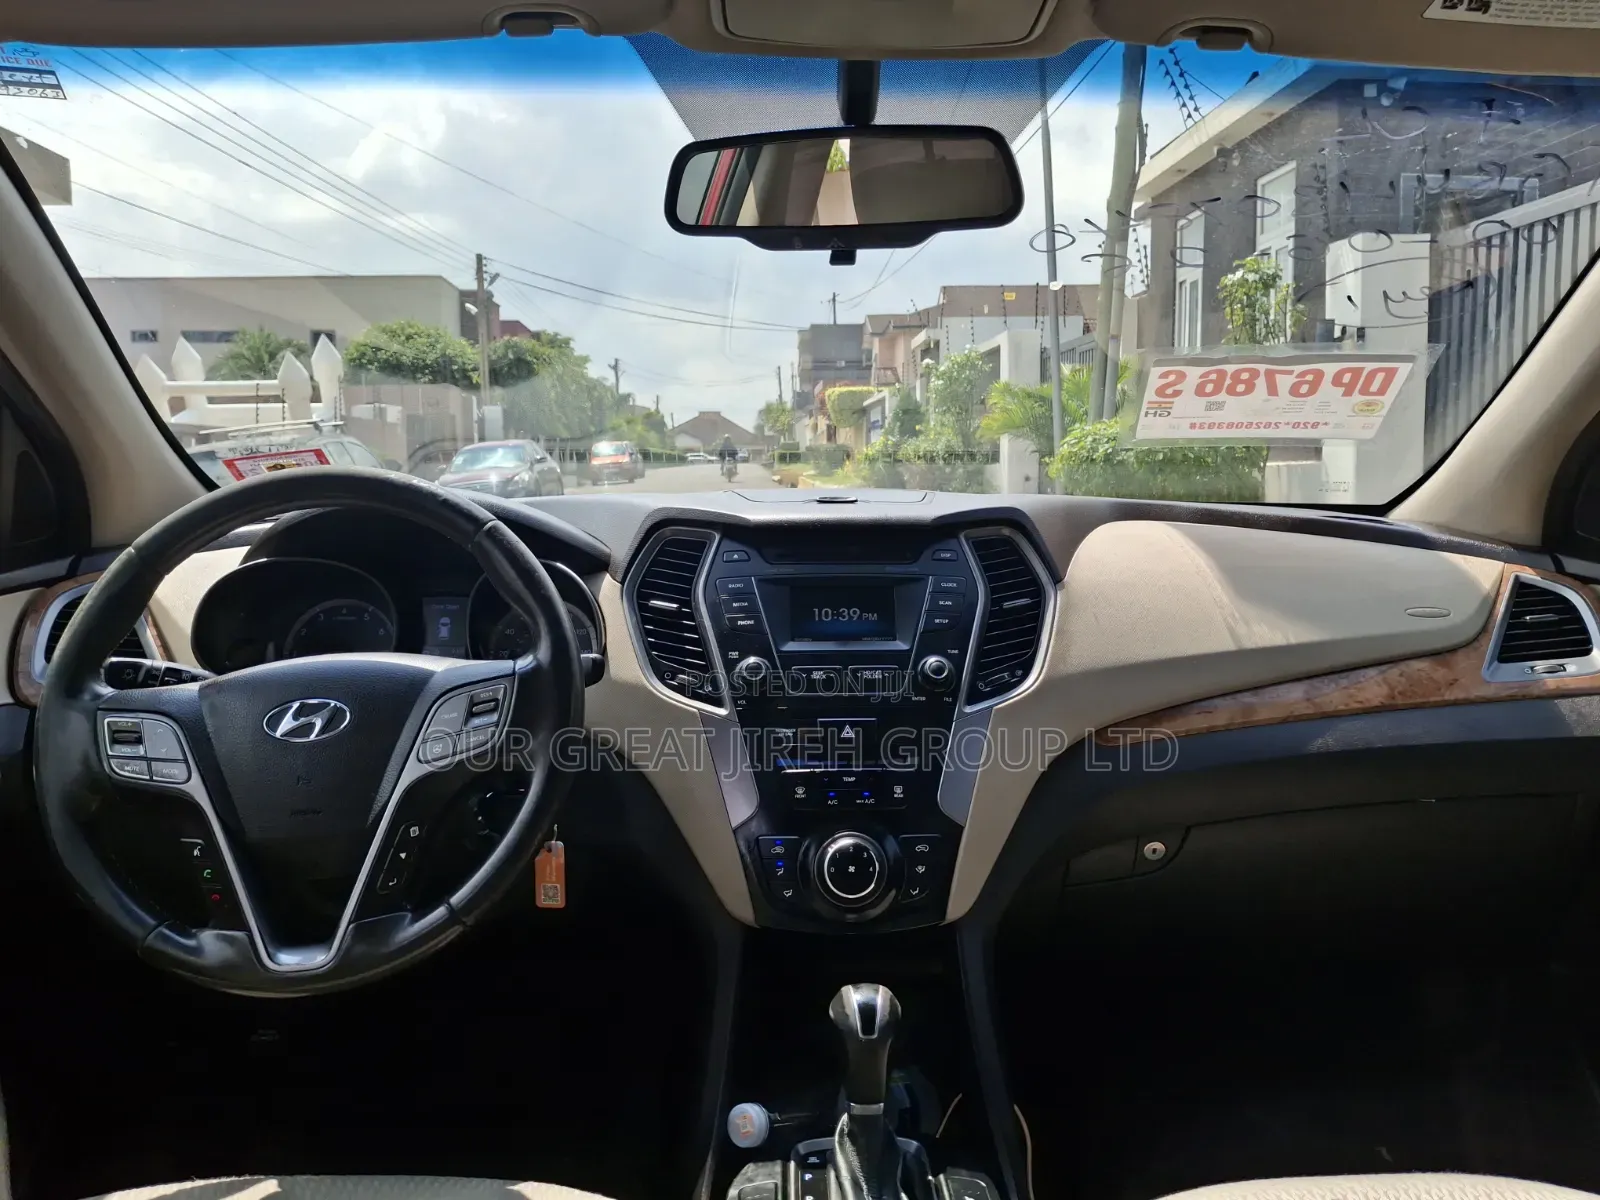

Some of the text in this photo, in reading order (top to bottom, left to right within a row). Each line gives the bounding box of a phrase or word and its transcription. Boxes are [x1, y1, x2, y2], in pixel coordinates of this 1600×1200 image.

[26, 58, 53, 67] DUE
[812, 607, 878, 621] 10:39 PM
[804, 1173, 813, 1181] P
